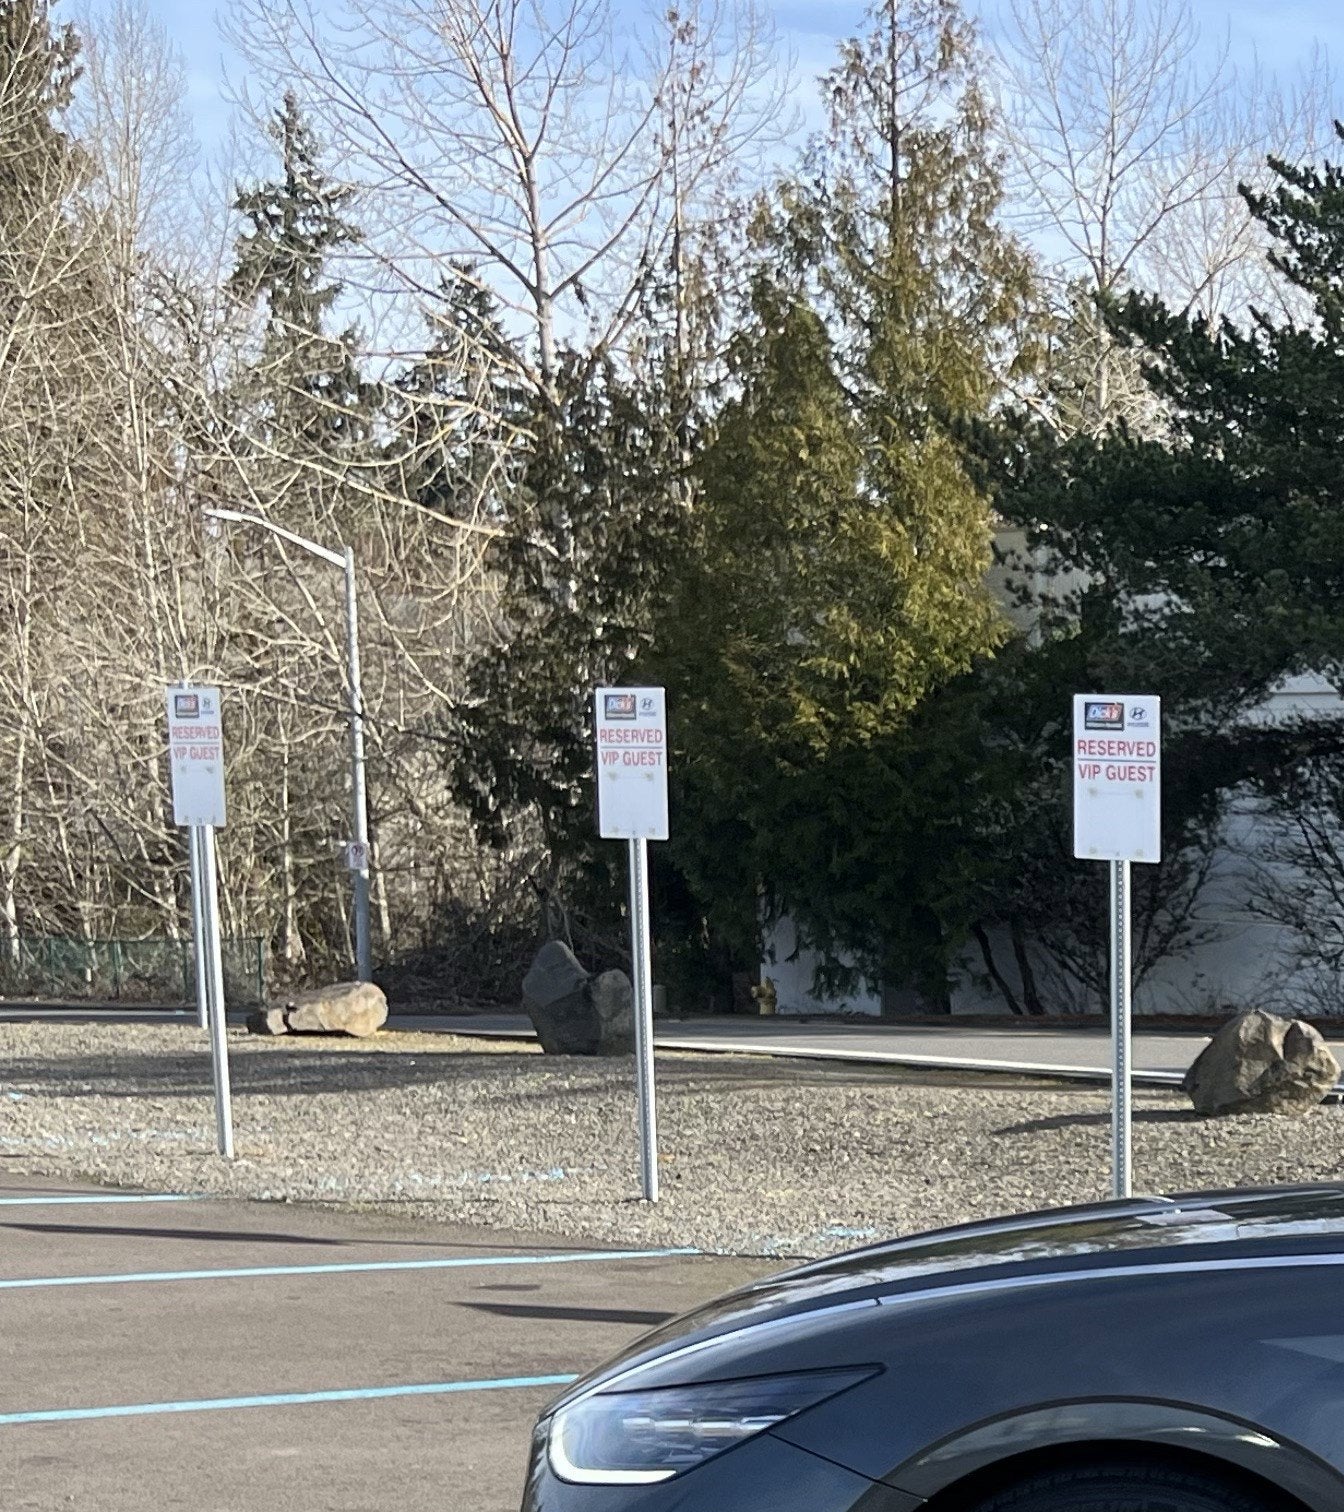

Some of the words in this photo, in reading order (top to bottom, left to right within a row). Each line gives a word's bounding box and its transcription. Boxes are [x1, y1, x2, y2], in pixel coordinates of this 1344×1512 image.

[172, 726, 219, 740] RESERVED
[600, 728, 663, 743] RESERVED
[173, 746, 187, 760] VIP
[190, 746, 219, 760] GUEST
[1077, 739, 1156, 758] RESERVED
[601, 751, 619, 766] VIP
[623, 751, 663, 766] GUEST
[1078, 763, 1101, 780] VIP
[1106, 764, 1156, 782] GUEST
